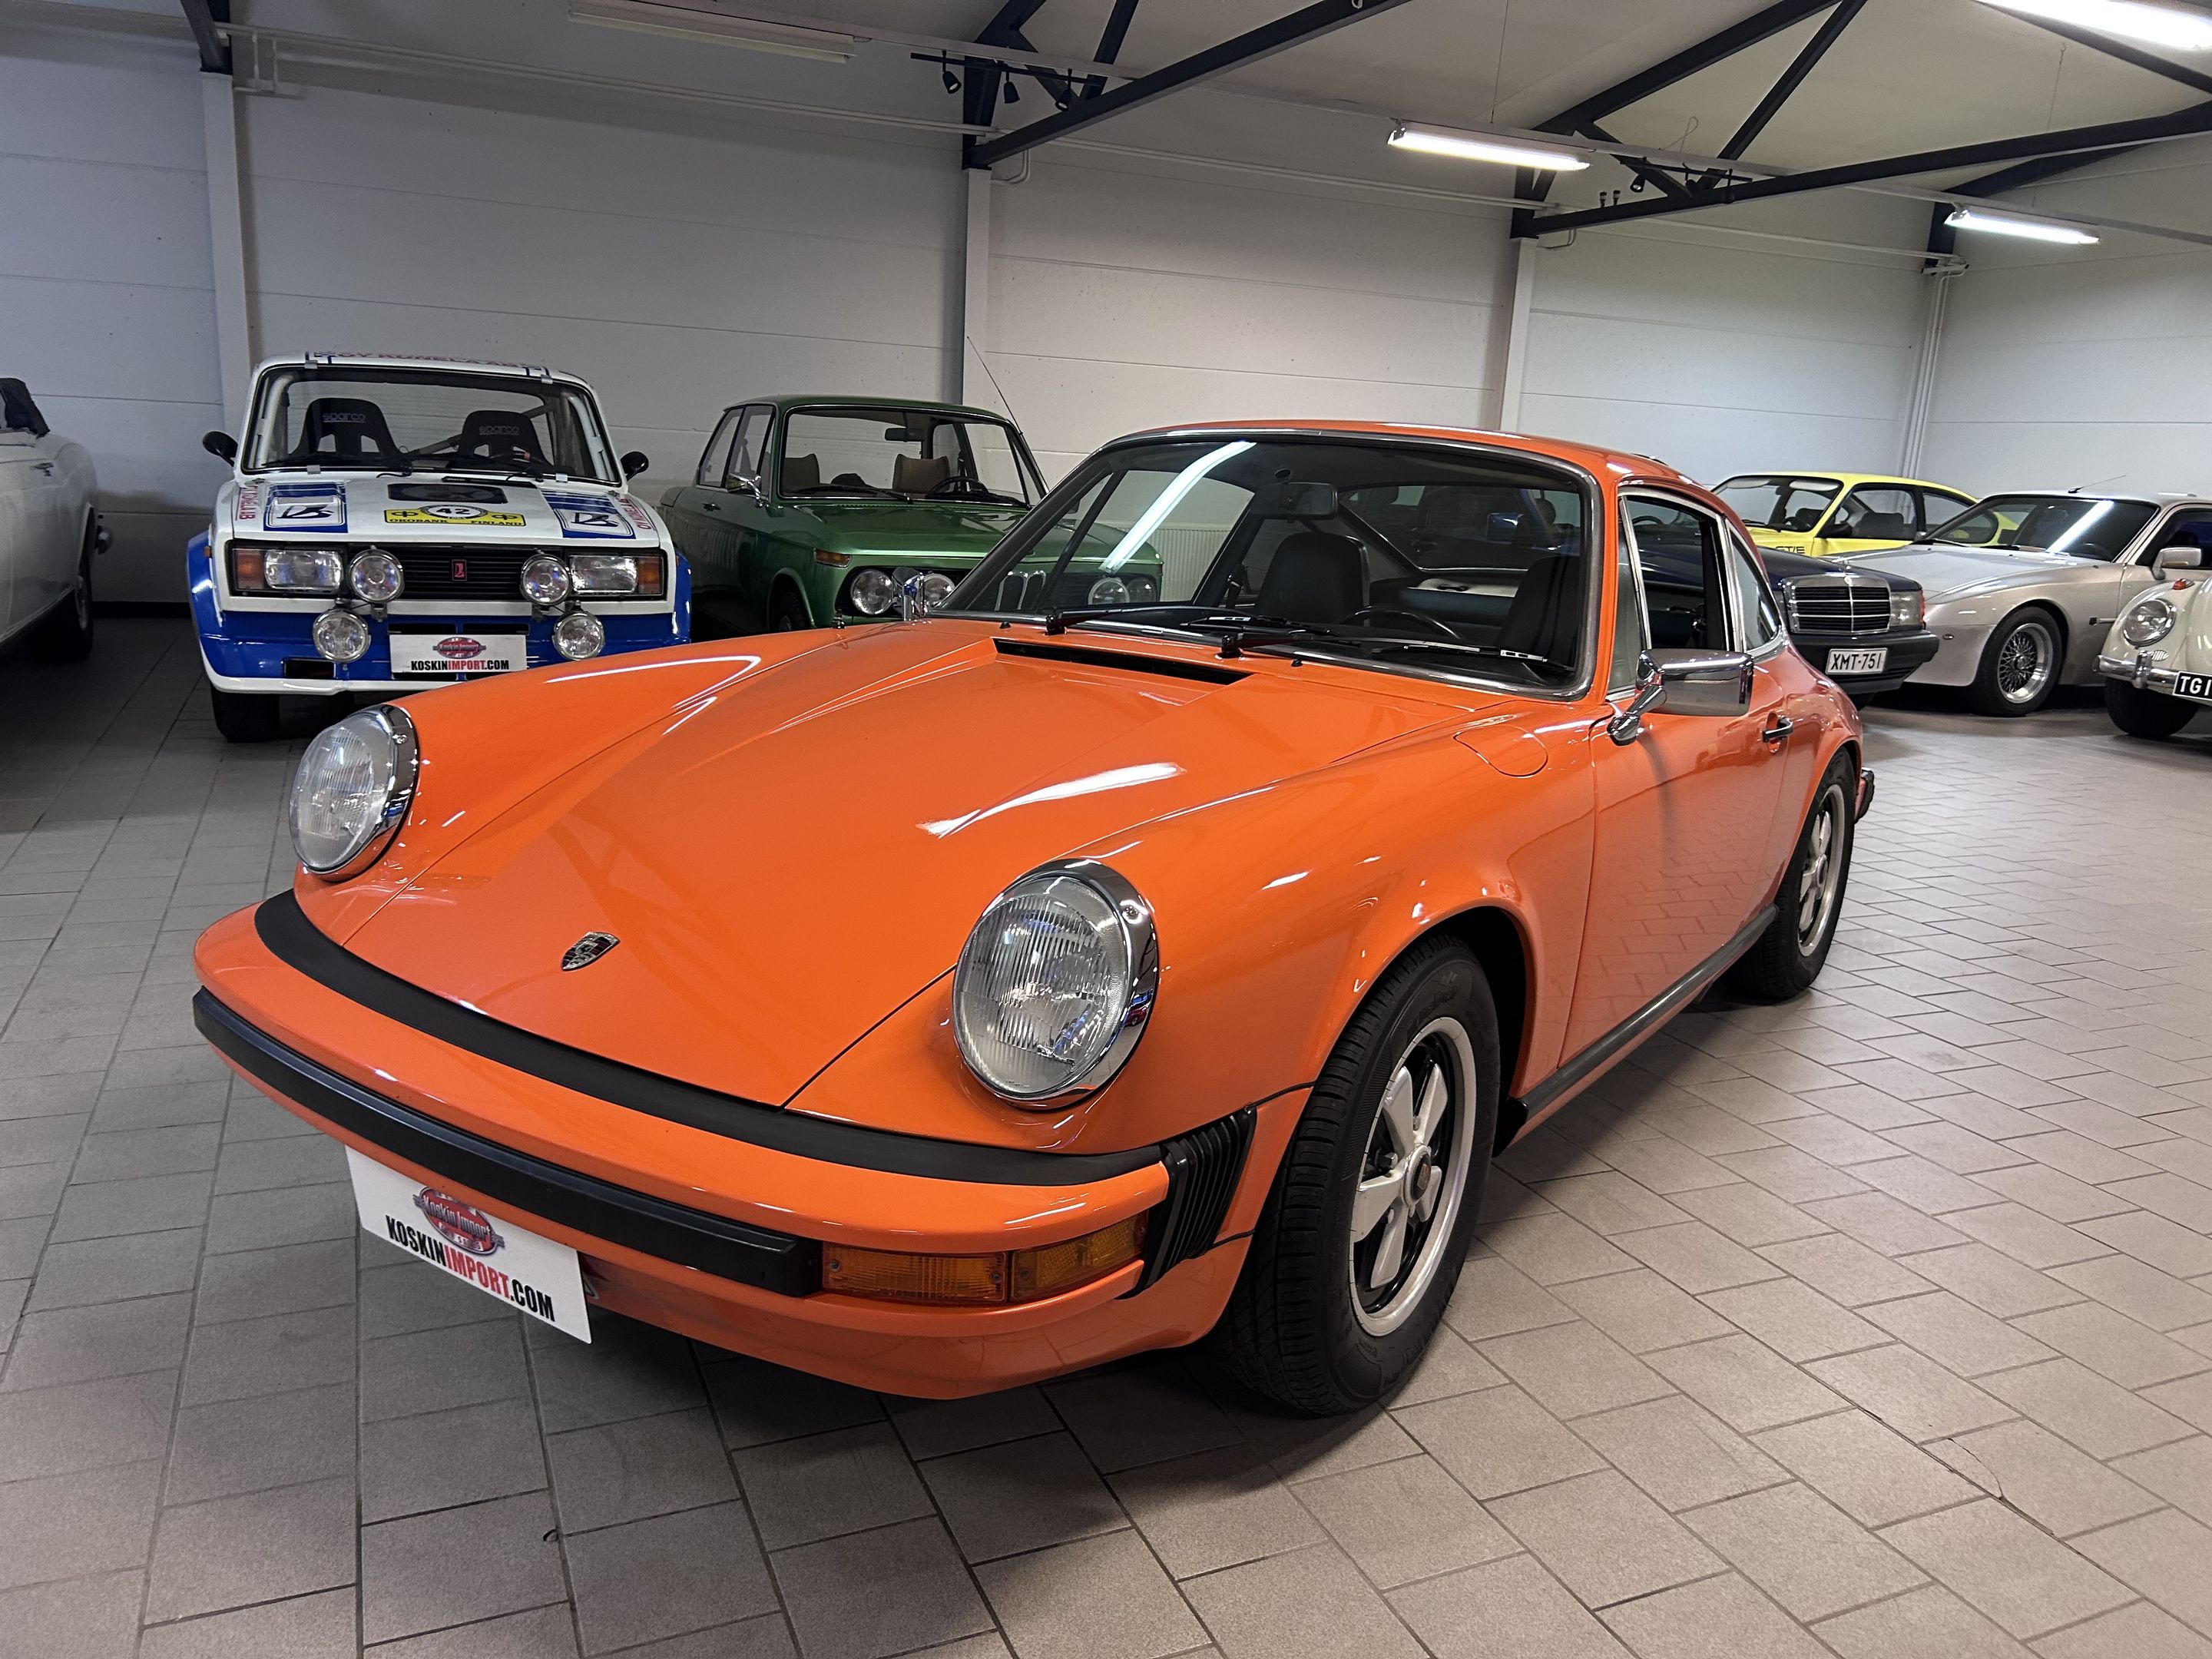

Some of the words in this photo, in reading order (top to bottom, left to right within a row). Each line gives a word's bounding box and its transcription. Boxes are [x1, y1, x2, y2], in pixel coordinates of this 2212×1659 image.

[323, 412, 366, 422] sparco
[478, 425, 519, 434] sparco
[411, 660, 509, 671] KOSKINIMPORT.COM
[1830, 652, 1883, 671] XMT-751
[422, 1194, 459, 1229] Koskin
[455, 1210, 492, 1249] Import
[385, 1214, 556, 1322] KOSKINIMPORT.COM
